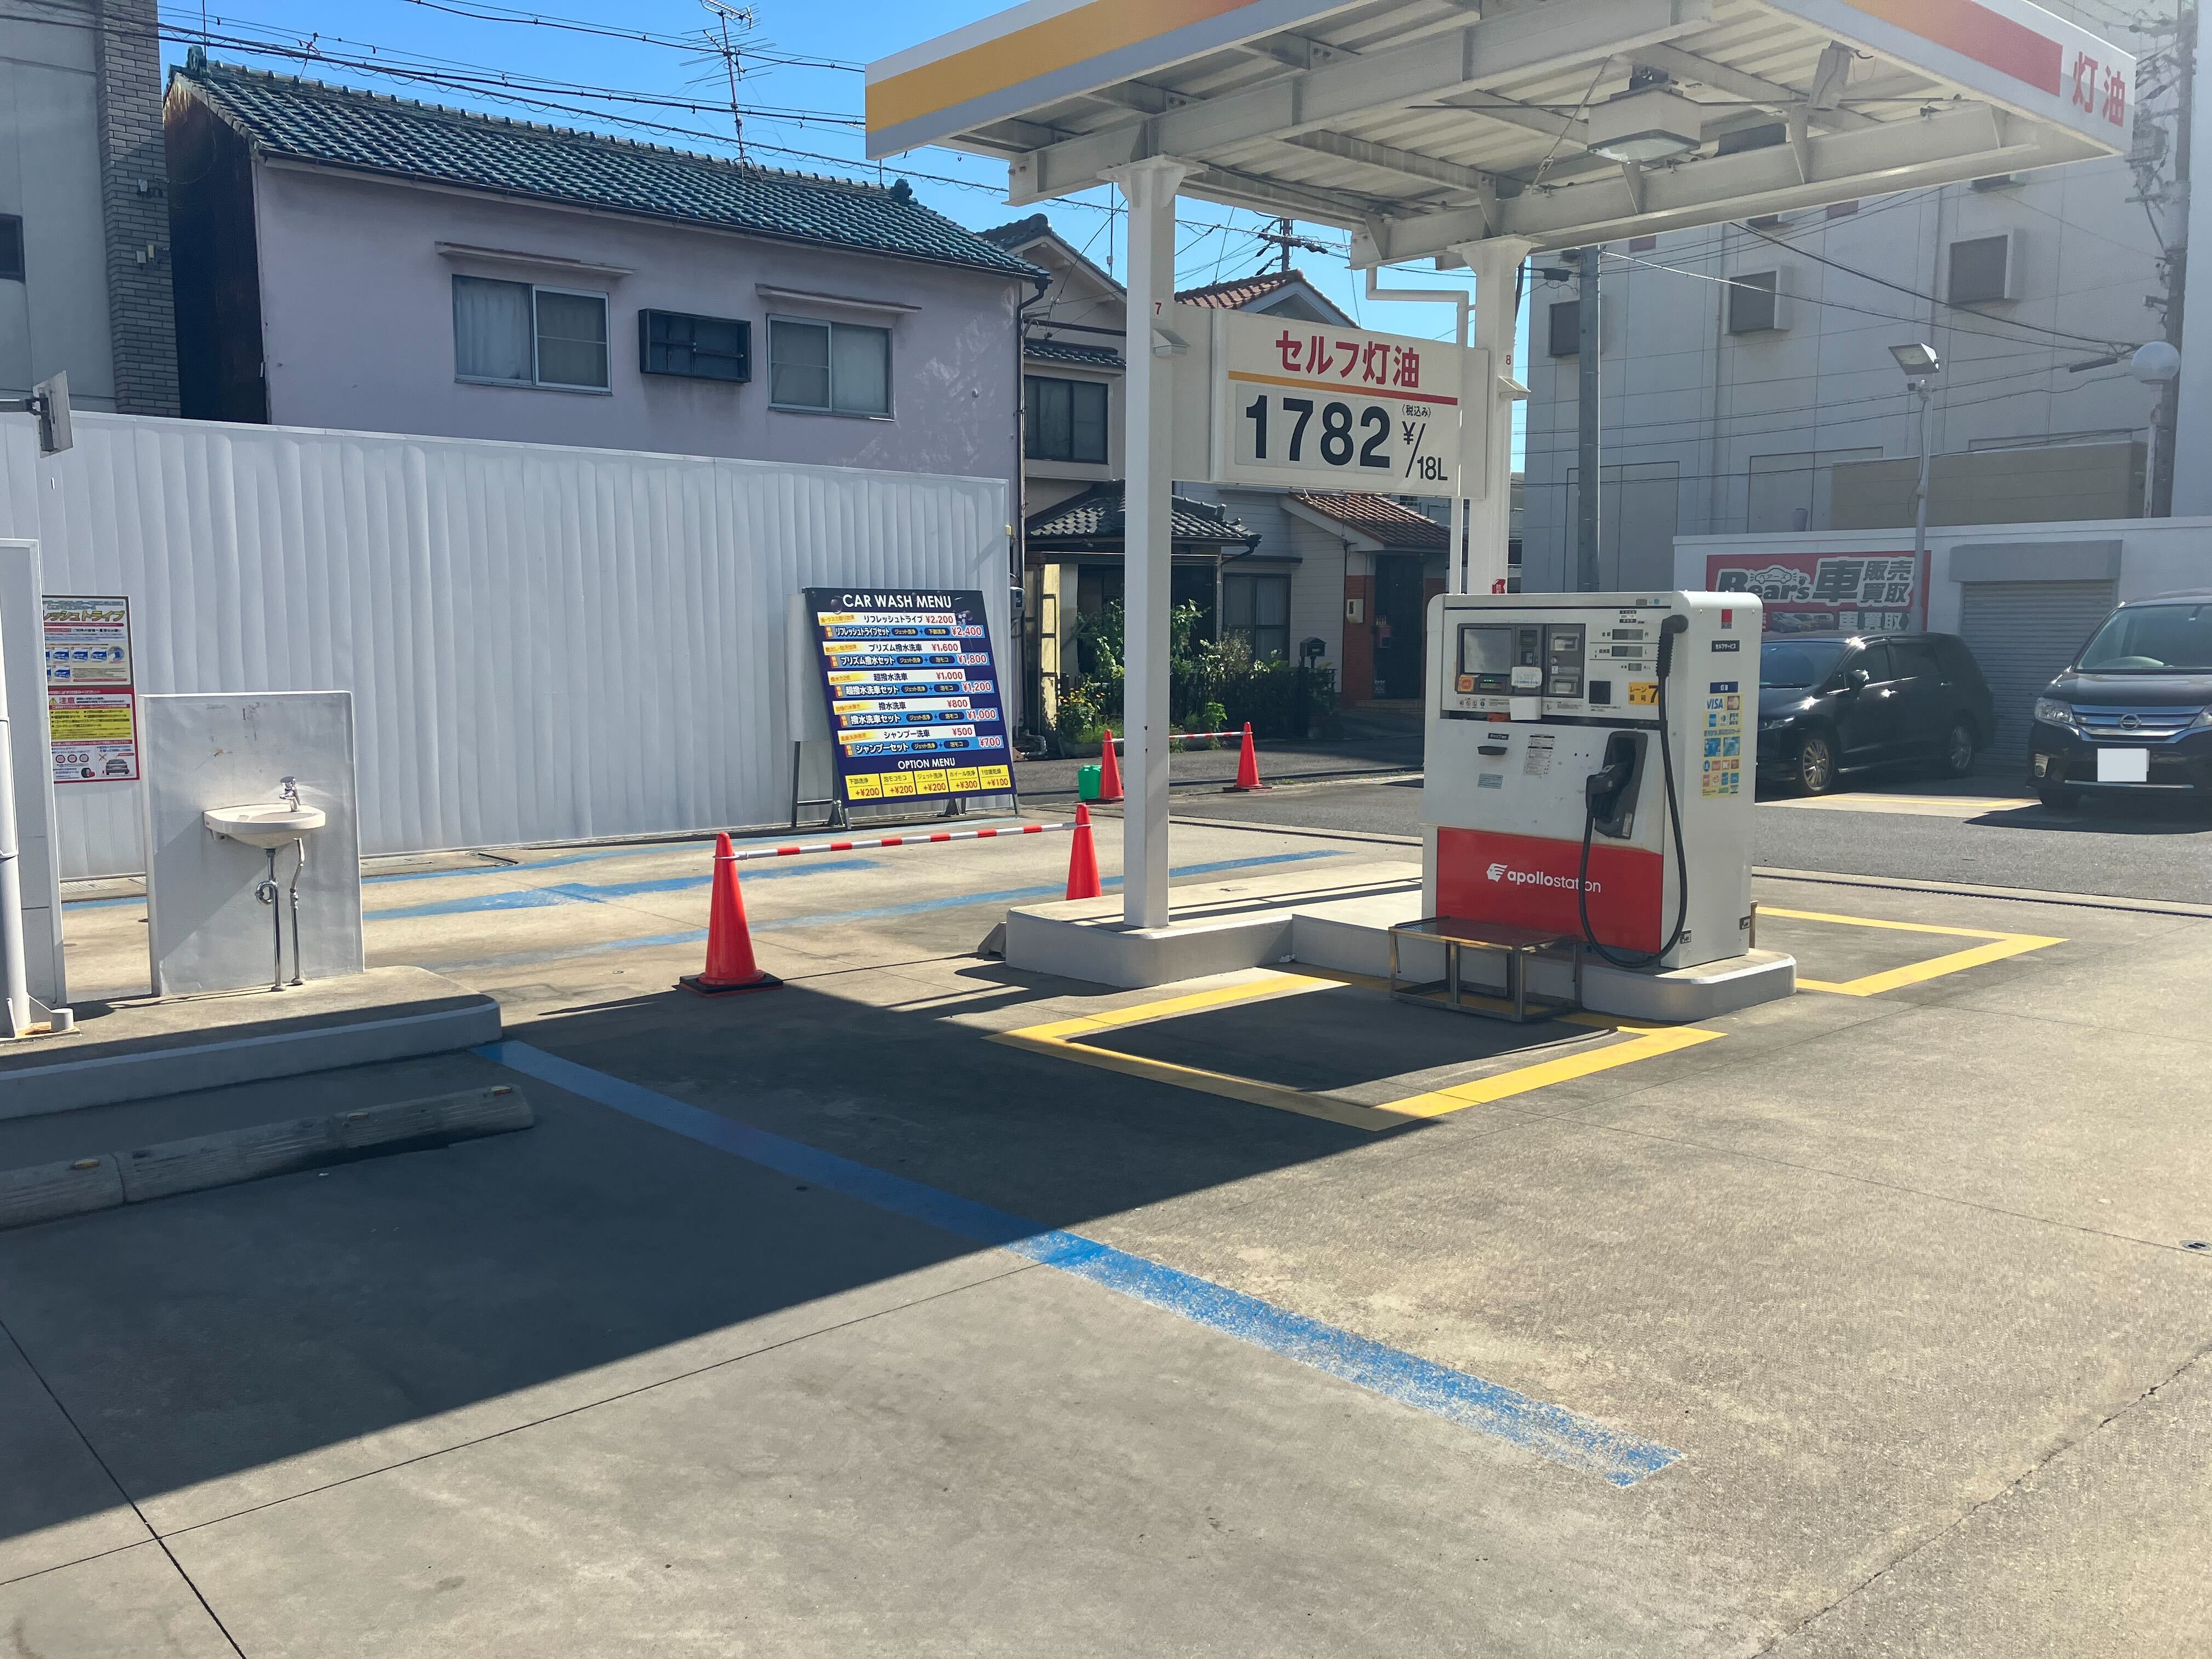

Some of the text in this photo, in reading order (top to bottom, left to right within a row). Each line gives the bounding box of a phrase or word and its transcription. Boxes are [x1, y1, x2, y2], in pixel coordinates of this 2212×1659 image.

[2073, 51, 2125, 127] 灯油
[1155, 302, 1162, 315] 7
[1276, 330, 1420, 388] セルフ灯油
[1505, 354, 1511, 365] 8
[1246, 394, 1391, 469] 1782
[1863, 560, 1914, 581] 販売
[1860, 583, 1910, 603] 買取
[842, 594, 952, 608] CAR WASH MENU
[926, 616, 953, 624] ¥2,200
[951, 627, 982, 636] ¥2,400
[931, 644, 958, 652] ¥1,600
[957, 654, 986, 665] ¥1,800
[873, 673, 908, 681] 超撥水洗車
[936, 672, 963, 680] ¥1,000
[845, 685, 899, 695] 超撥水洗車セット
[962, 682, 991, 692] ¥1,200
[1648, 685, 1659, 703] 7
[878, 702, 907, 710] 撥水洗車
[947, 699, 968, 708] ¥800
[1707, 698, 1723, 710] VISA
[850, 713, 900, 725] 撥水洗車セット
[967, 709, 996, 721] ¥1,000
[884, 729, 931, 739] シャンプー洗車
[952, 727, 973, 736] ¥500
[856, 742, 909, 754] シャンプーセット
[979, 737, 1001, 747] ¥700
[898, 757, 956, 770] OPTION MENU
[917, 771, 943, 780] ジェット洗浄
[923, 783, 946, 792] +¥200
[956, 780, 978, 789] +¥300
[988, 778, 1008, 787] +¥100
[855, 787, 879, 797] +¥200
[890, 785, 913, 794] +¥200
[1507, 871, 1601, 893] apollostaton
